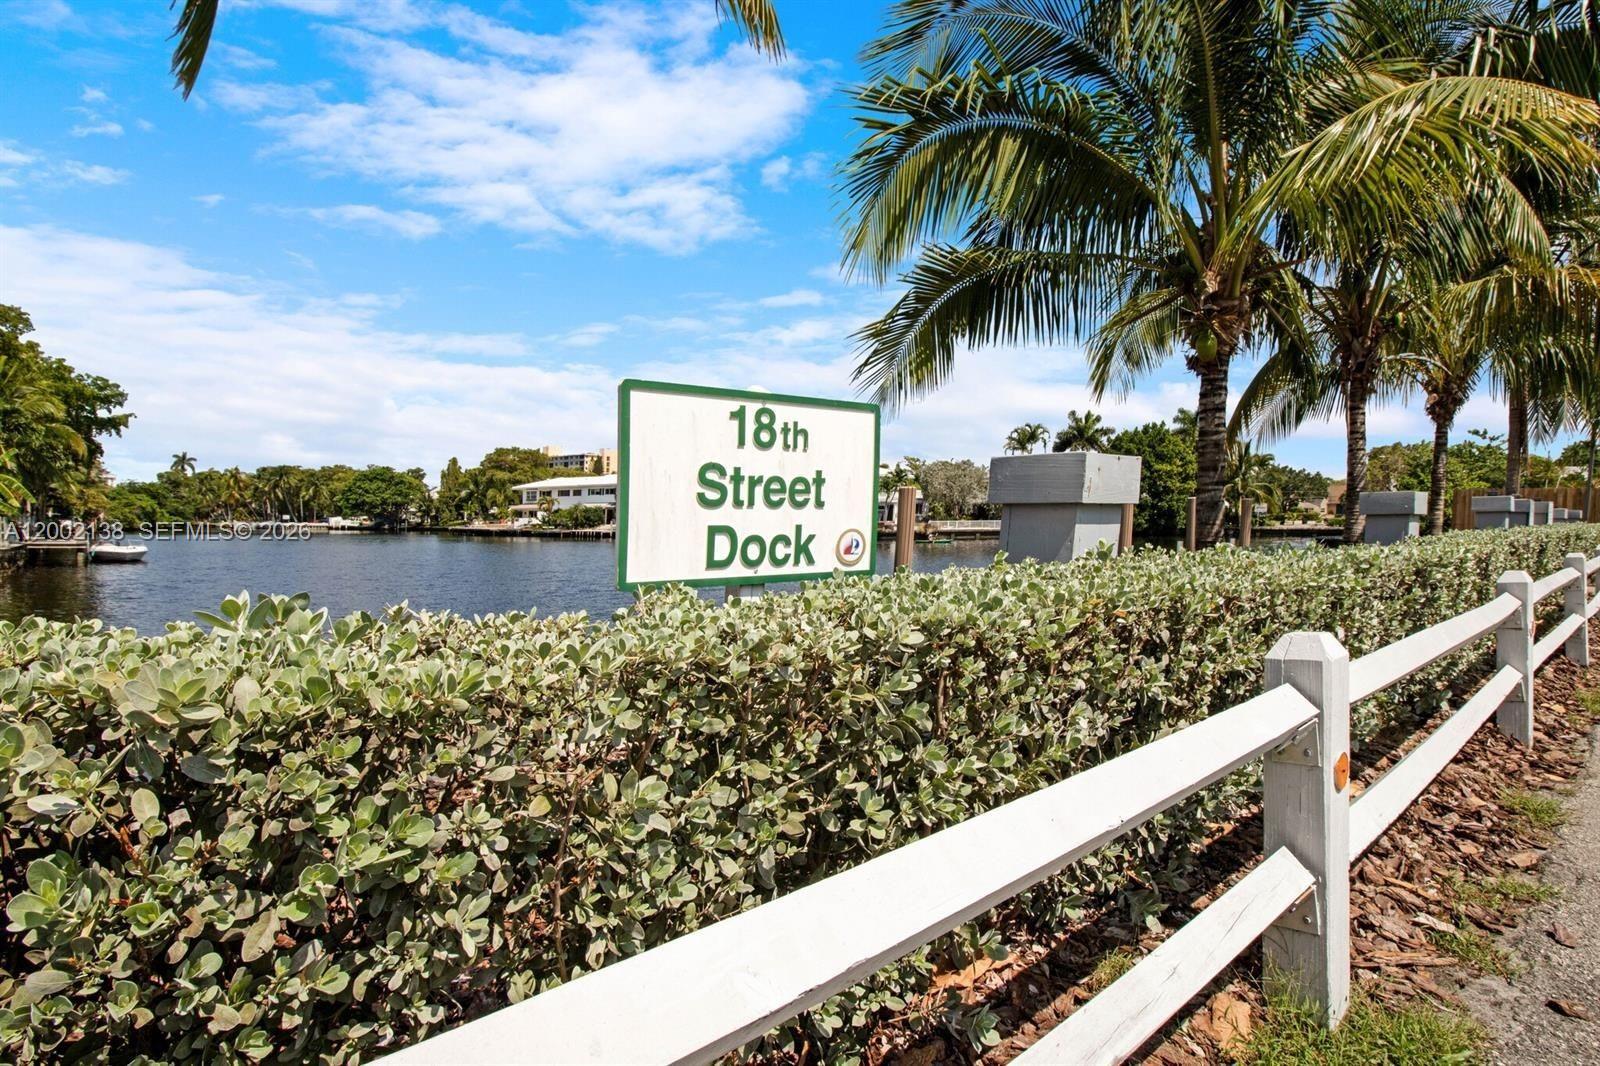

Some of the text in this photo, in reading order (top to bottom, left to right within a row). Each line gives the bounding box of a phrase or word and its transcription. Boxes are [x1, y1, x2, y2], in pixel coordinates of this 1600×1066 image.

[729, 405, 809, 452] 18th
[696, 462, 826, 509] Street
[705, 524, 816, 570] Dock
